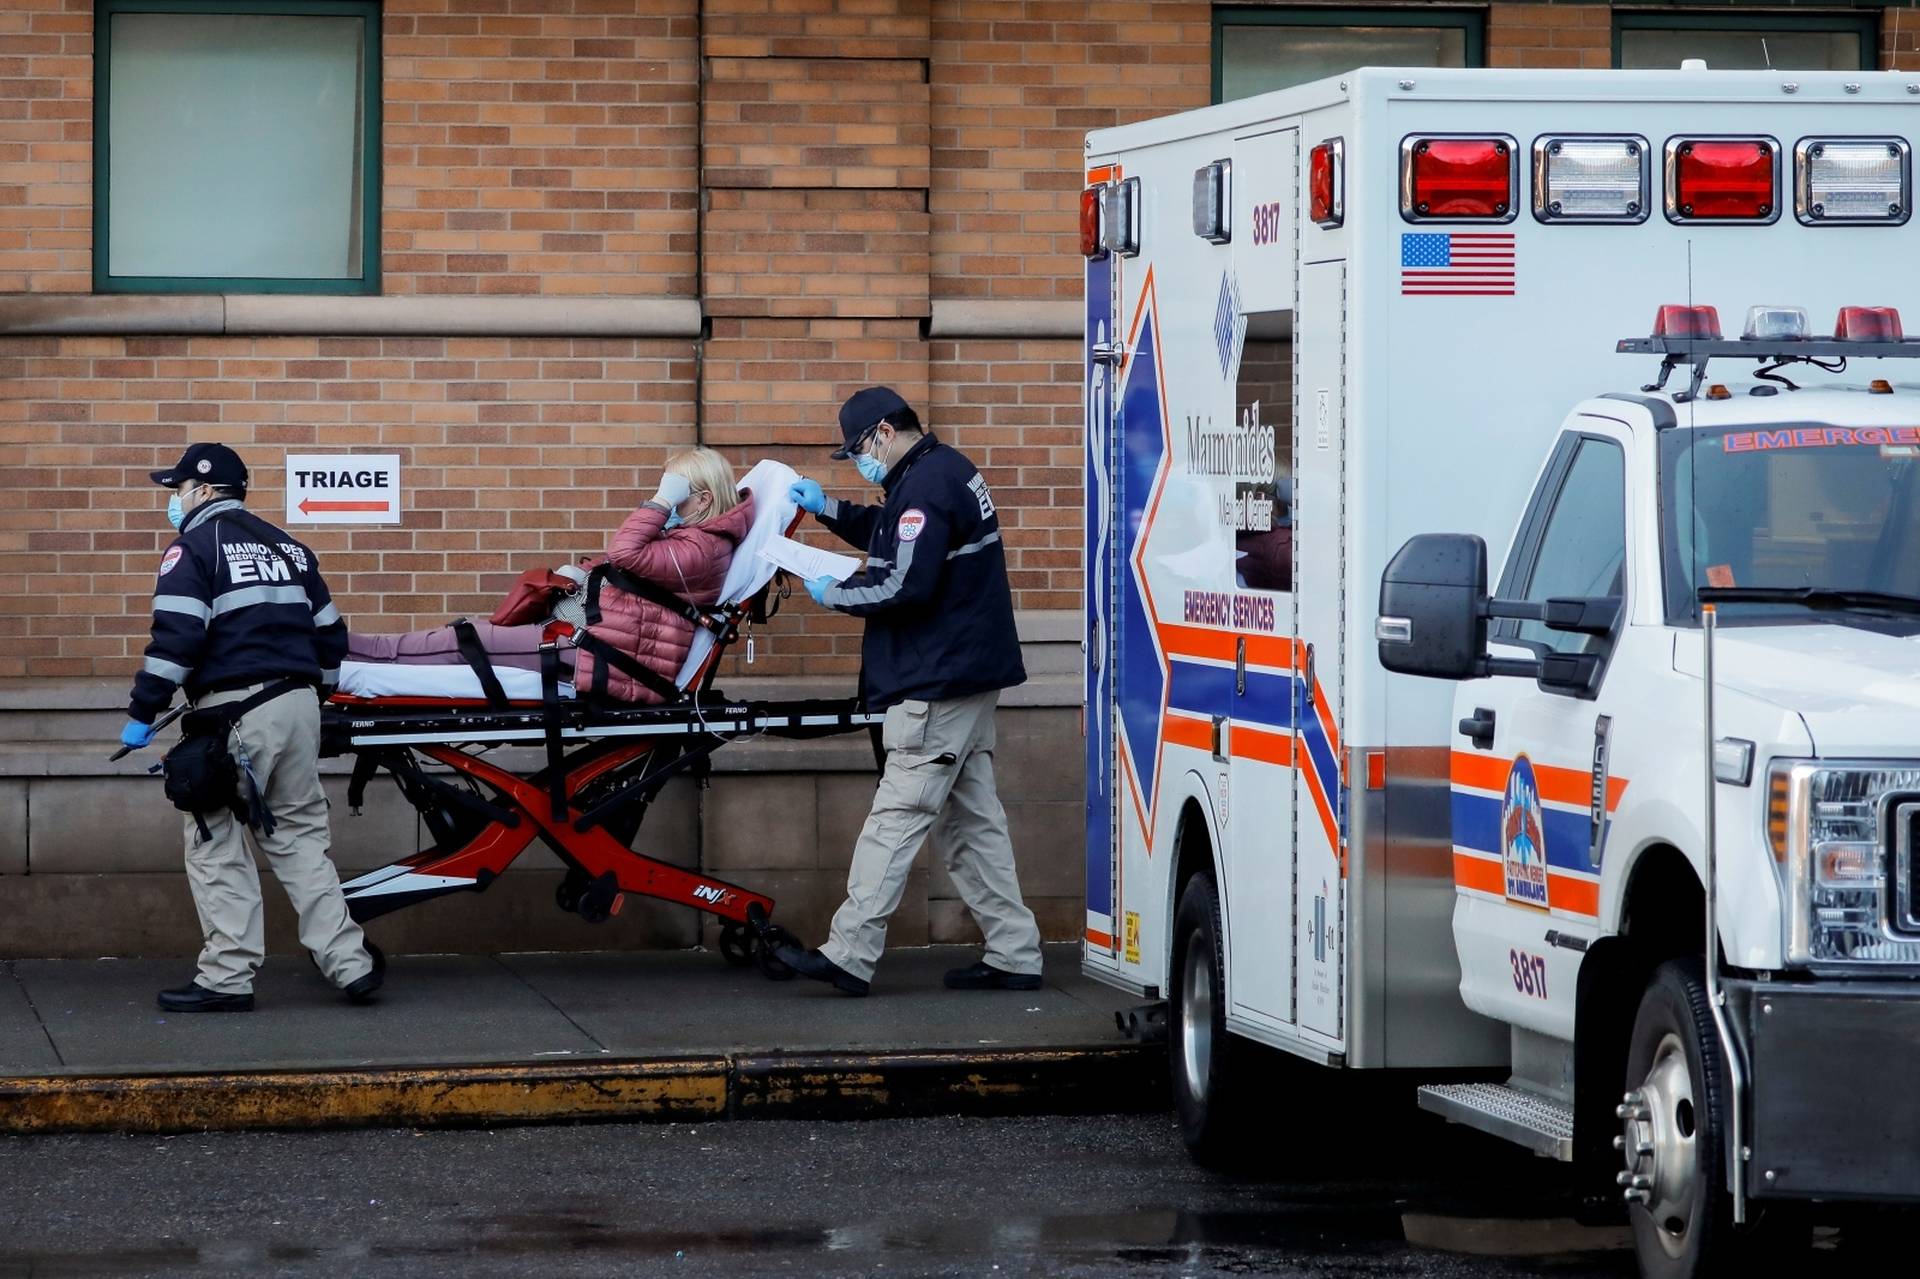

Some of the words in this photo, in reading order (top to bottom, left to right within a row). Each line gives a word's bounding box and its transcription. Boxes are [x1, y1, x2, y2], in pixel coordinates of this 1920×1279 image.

[1253, 202, 1280, 246] 3817
[1186, 401, 1275, 478] Maimonides
[295, 471, 389, 488] TRIAGE
[1218, 492, 1247, 528] Mecal
[1247, 491, 1273, 530] Center
[222, 542, 305, 557] MAIMODES
[226, 554, 270, 563] MEDICAL
[270, 554, 307, 565] CTER
[1184, 589, 1231, 627] EMERGENCY
[1233, 593, 1275, 632] SERVICES
[351, 720, 375, 728] FERNO
[725, 706, 748, 714] FERNO
[1510, 948, 1547, 1000] 3817
